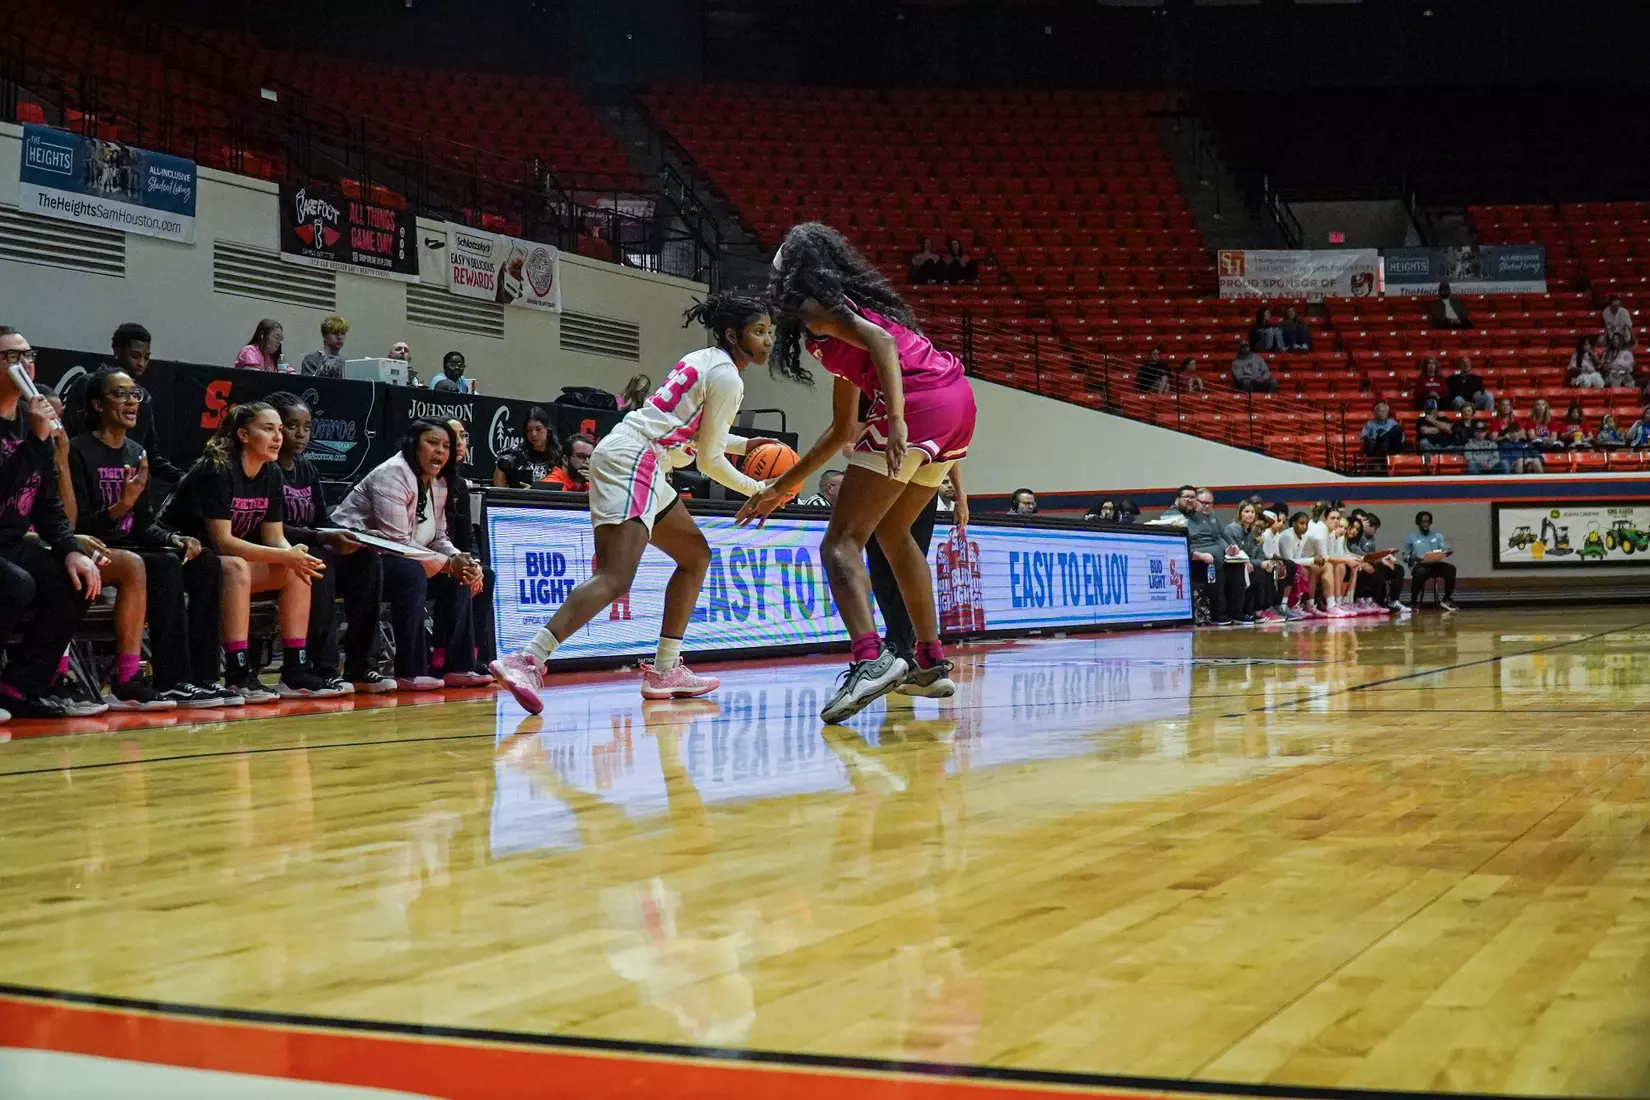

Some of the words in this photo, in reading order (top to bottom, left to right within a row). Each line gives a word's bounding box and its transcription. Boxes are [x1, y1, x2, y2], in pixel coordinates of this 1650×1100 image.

[31, 135, 41, 145] THE
[29, 146, 71, 169] HEIGHTS
[149, 166, 191, 182] ALL-INCLUSIVE
[38, 192, 182, 234] TheHeightsSamHouston.com
[296, 188, 340, 225] BAREFOOT
[349, 202, 365, 225] ALL
[366, 205, 396, 232] THINGS
[351, 227, 376, 251] GAME
[457, 236, 491, 253] Schlotzsky's
[450, 252, 465, 266] EASY
[470, 258, 495, 273] DELICIOUS
[1389, 261, 1427, 273] HEIGHTS
[453, 266, 494, 291] REWARDS
[1220, 279, 1259, 288] PROUD
[1262, 278, 1318, 289] SPONSOR
[1321, 278, 1337, 287] OF
[408, 399, 474, 423] JOHNSON
[525, 551, 566, 577] BUD
[1149, 559, 1163, 574] BUD
[771, 547, 816, 622] TO
[1009, 550, 1055, 608] EASY
[1057, 551, 1081, 607] TO
[1084, 552, 1129, 606] ENJOY
[1148, 574, 1166, 589] LIGHT
[519, 579, 575, 605] LIGHT
